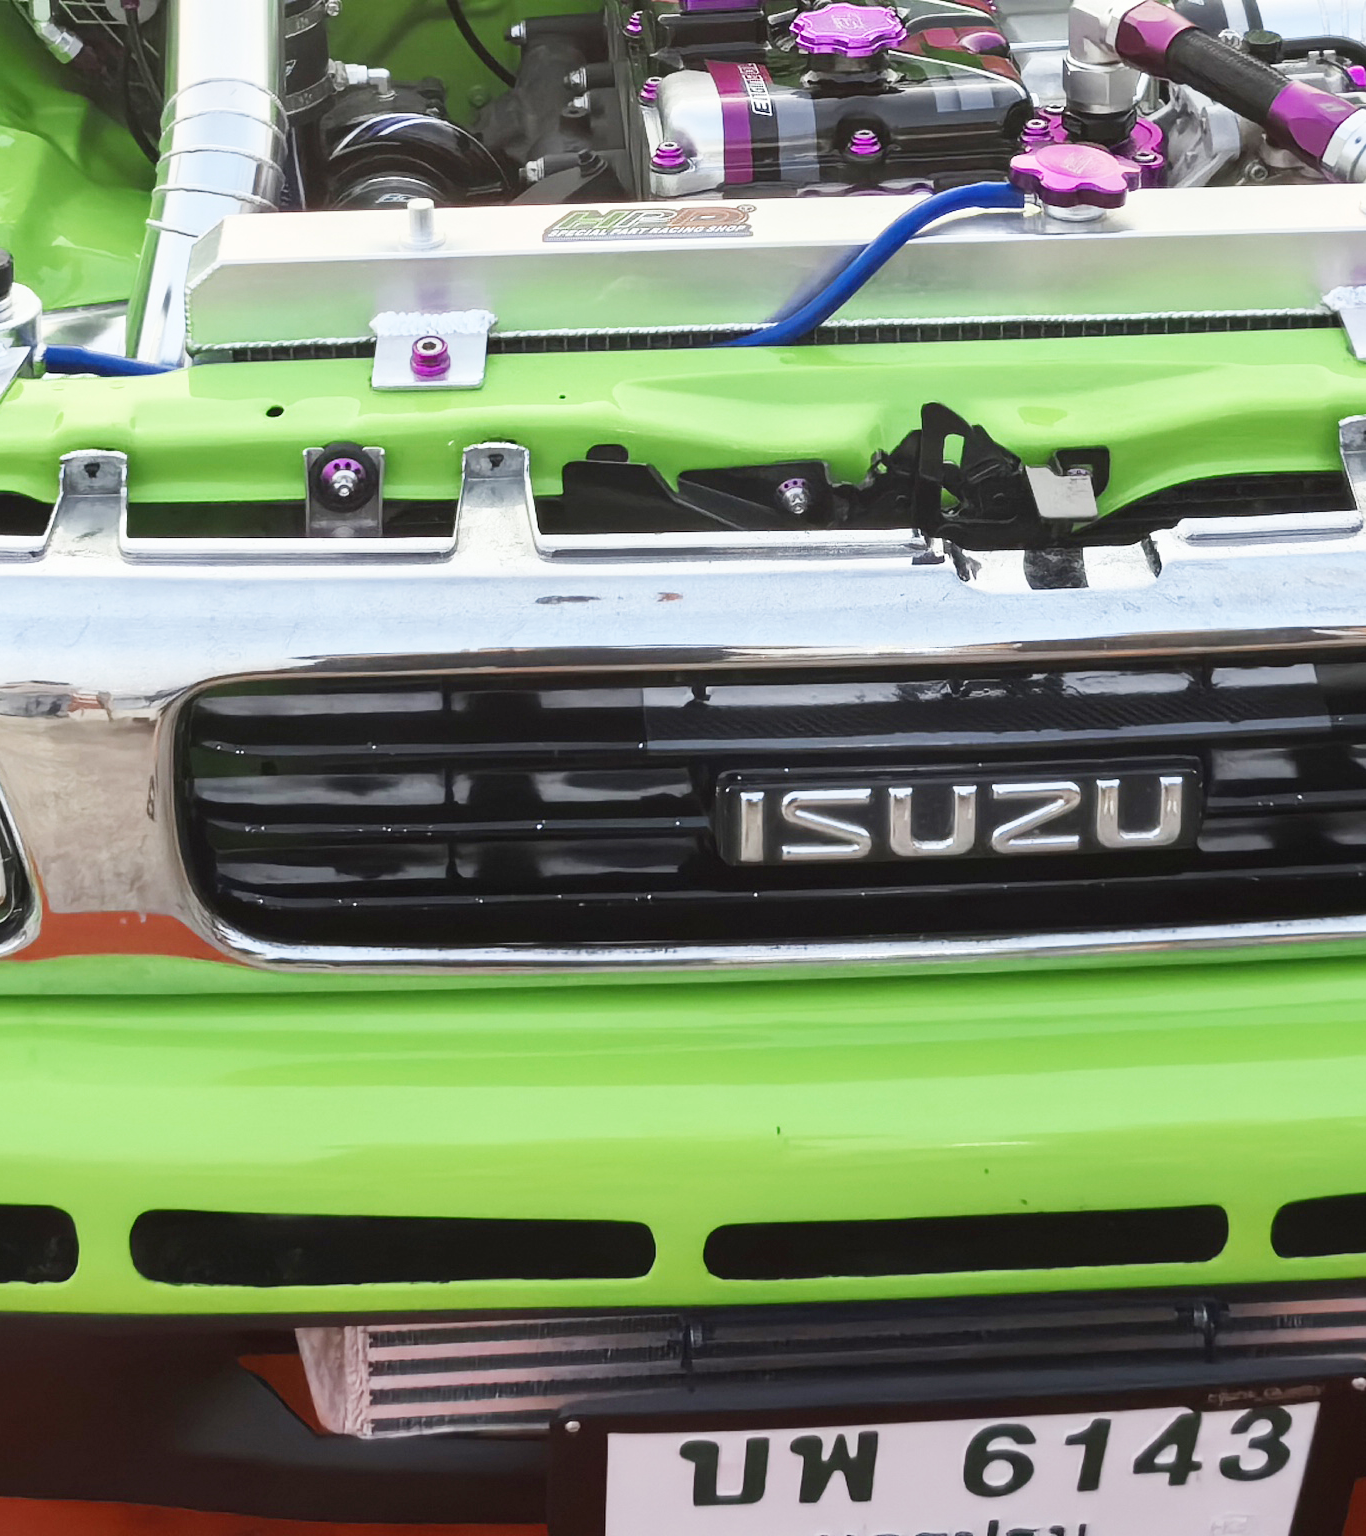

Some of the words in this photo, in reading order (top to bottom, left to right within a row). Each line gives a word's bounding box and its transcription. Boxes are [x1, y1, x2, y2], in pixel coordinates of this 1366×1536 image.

[547, 227, 609, 238] SPECIAL
[609, 226, 649, 237] PART
[647, 225, 705, 235] RACING
[707, 224, 747, 233] SHOP
[555, 207, 749, 230] HPD
[738, 776, 1185, 863] ISUZU
[678, 1429, 879, 1506] บพ
[962, 1405, 1293, 1498] 6143
